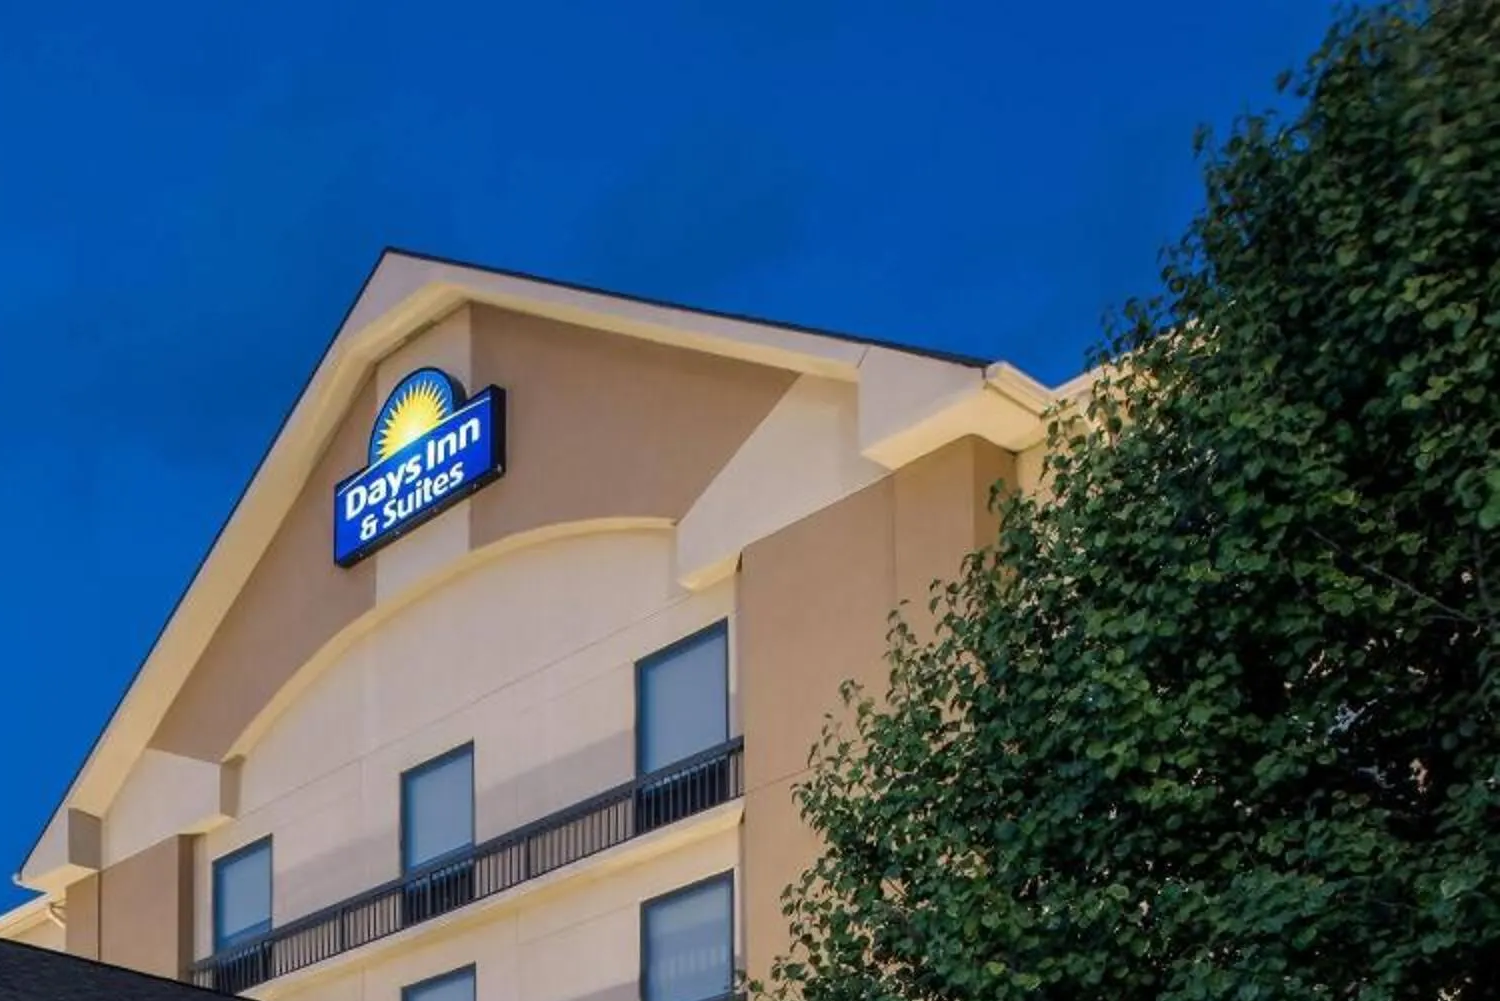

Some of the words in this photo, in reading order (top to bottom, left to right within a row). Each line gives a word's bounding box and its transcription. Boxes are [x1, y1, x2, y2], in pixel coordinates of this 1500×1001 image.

[345, 454, 422, 521] Days
[426, 417, 481, 471] Inn
[359, 514, 378, 541] &
[383, 461, 465, 529] Suites
